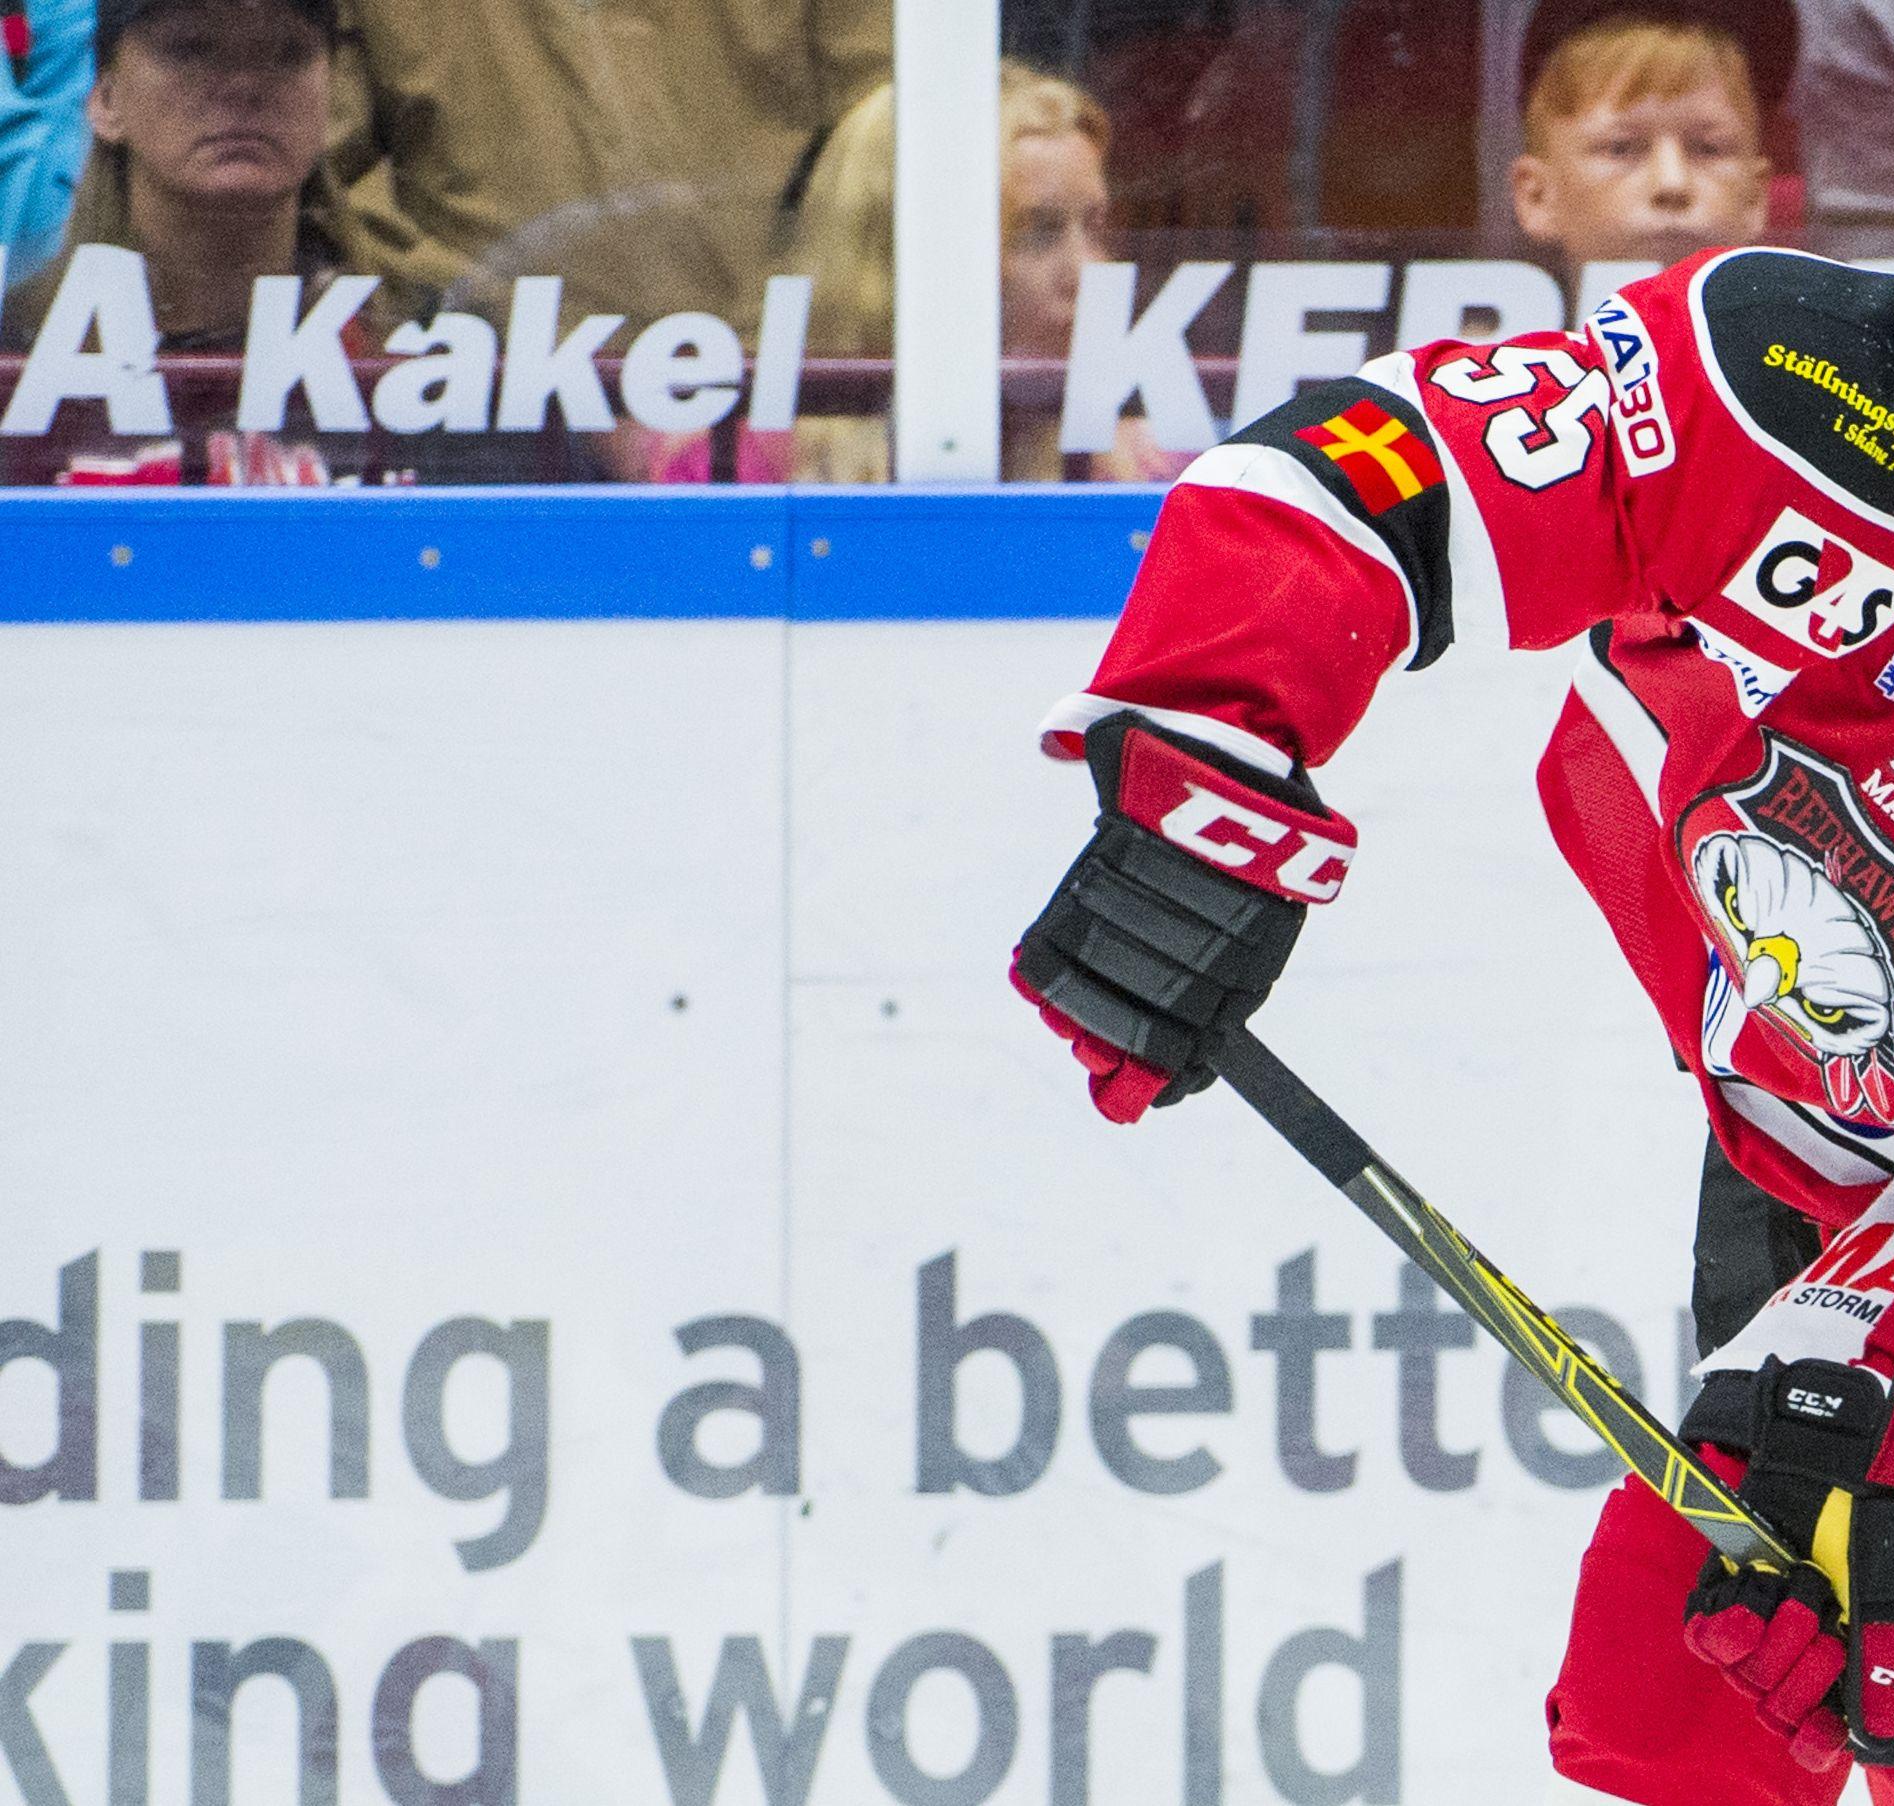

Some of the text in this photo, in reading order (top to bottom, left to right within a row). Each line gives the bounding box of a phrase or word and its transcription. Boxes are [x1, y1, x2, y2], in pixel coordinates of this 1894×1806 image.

[0, 243, 814, 436] A Kakel
[1427, 345, 1610, 492] 55
[1833, 414, 1844, 432] i
[1755, 537, 1894, 653] G4S
[1794, 1287, 1884, 1326] STORM
[655, 1312, 803, 1500] a
[1787, 1387, 1843, 1410] CCM
[627, 1557, 1407, 1806] world
